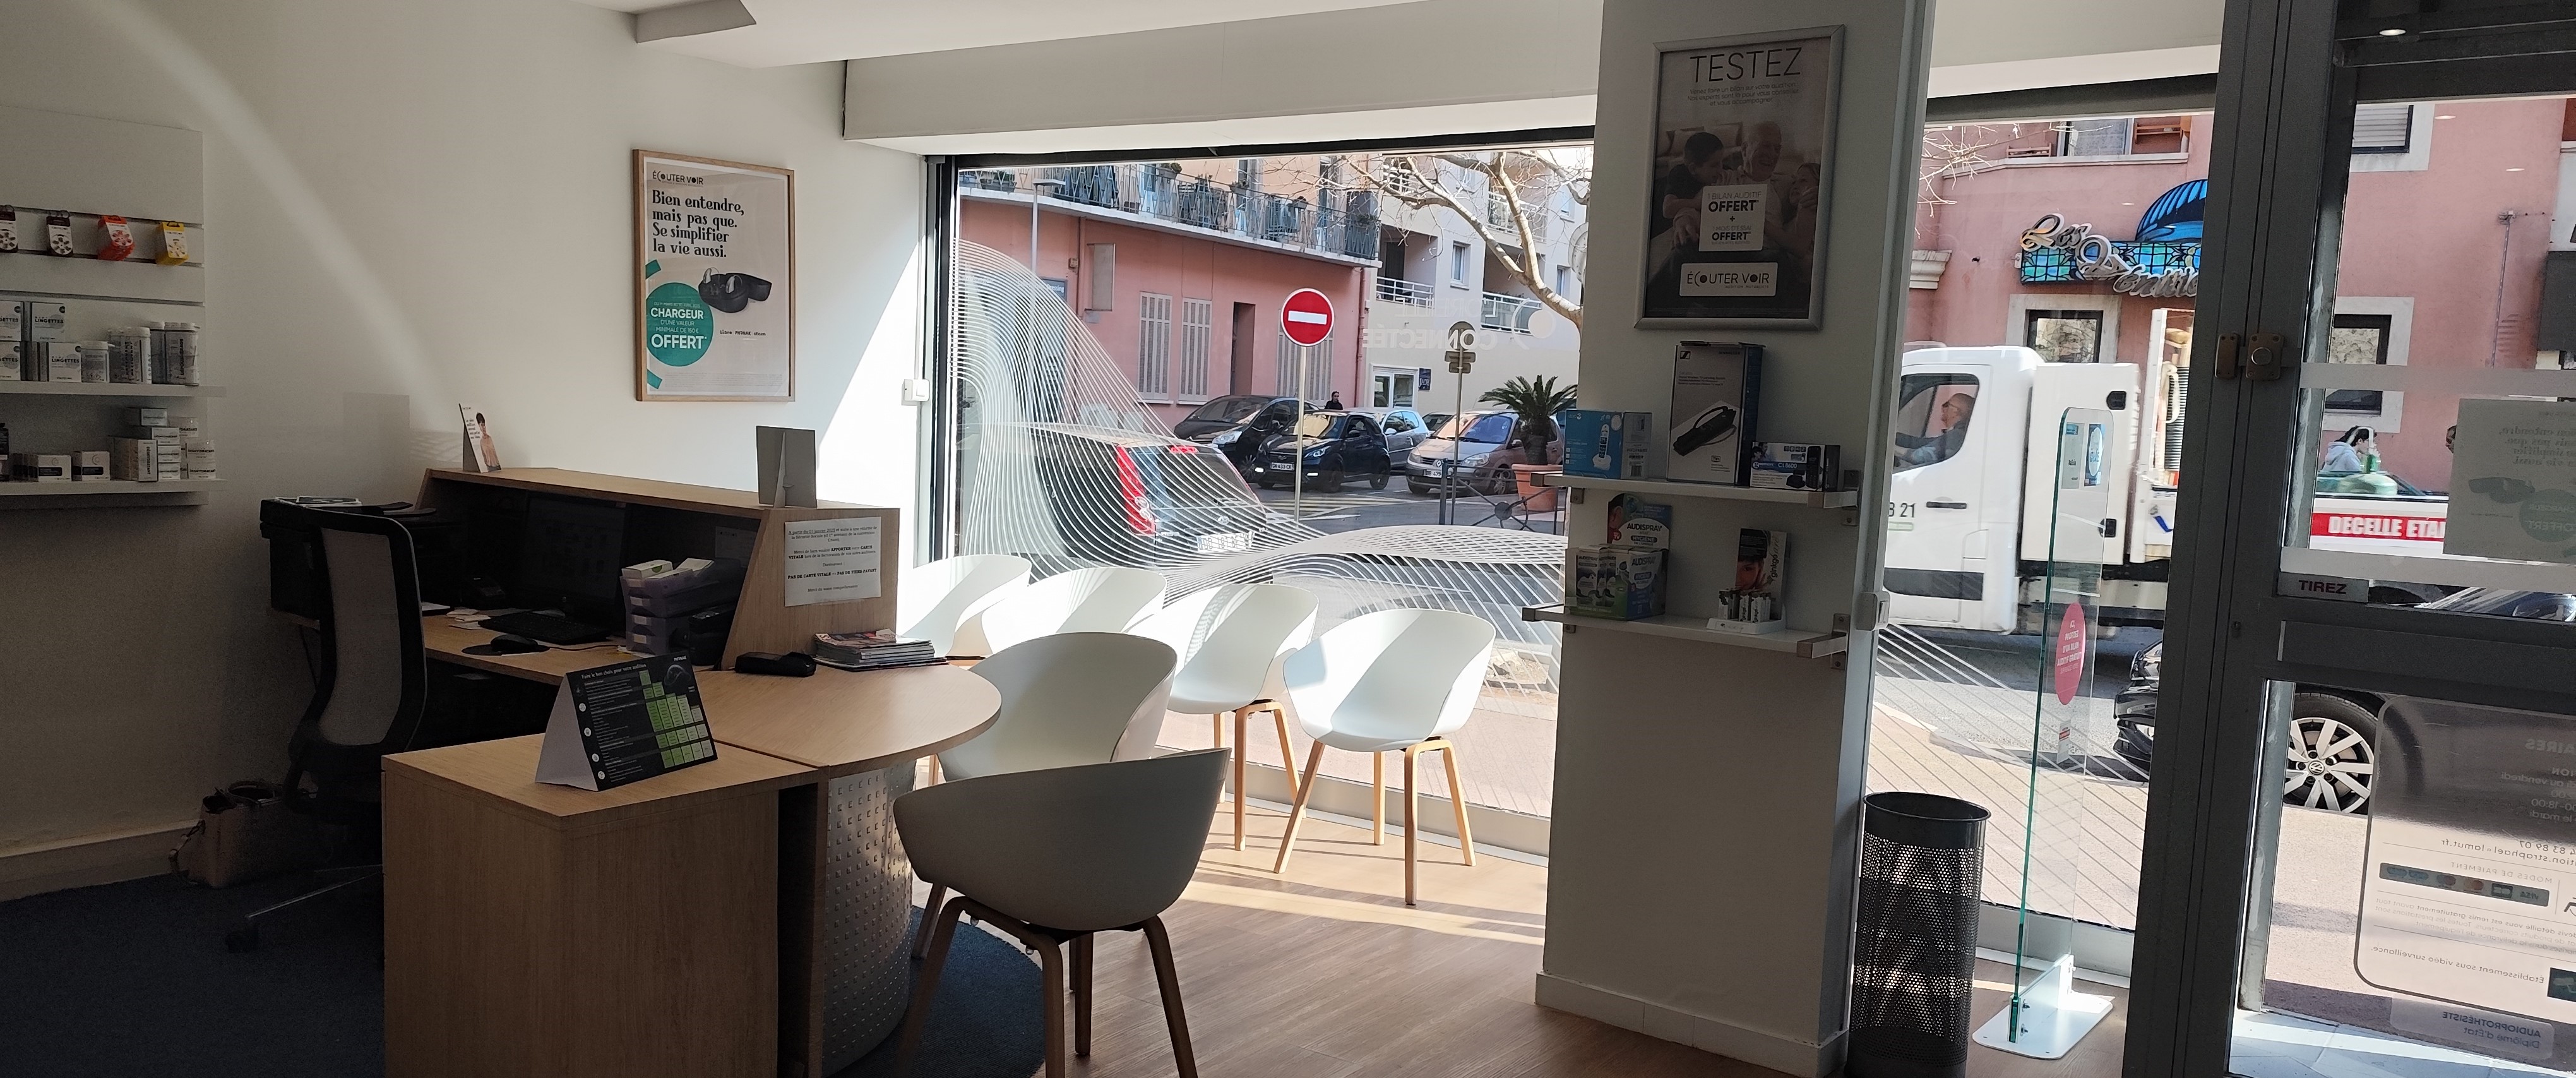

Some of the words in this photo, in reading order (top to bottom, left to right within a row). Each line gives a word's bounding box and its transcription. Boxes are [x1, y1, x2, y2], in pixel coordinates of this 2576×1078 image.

[1690, 47, 1801, 83] TESTEZ
[653, 170, 685, 183] ÉCOUTER
[686, 176, 703, 185] VOIR
[653, 189, 681, 206] Bien
[685, 196, 744, 216] entendre,
[653, 208, 681, 222] mais
[687, 214, 708, 229] pas
[713, 217, 737, 231] que.
[653, 222, 667, 237] Se
[671, 225, 729, 244] simplifier
[653, 238, 665, 253] la
[671, 241, 690, 255] vie
[694, 245, 727, 258] aussi.
[1687, 271, 1739, 287] ÉCOUTER
[1742, 273, 1770, 284] VOIR
[650, 307, 704, 320] CHARGEUR
[1900, 502, 1916, 518] 21
[1627, 523, 1662, 532] AUDISPRAY
[2328, 516, 2403, 537] DECELLE
[2298, 580, 2347, 595] TIREZ
